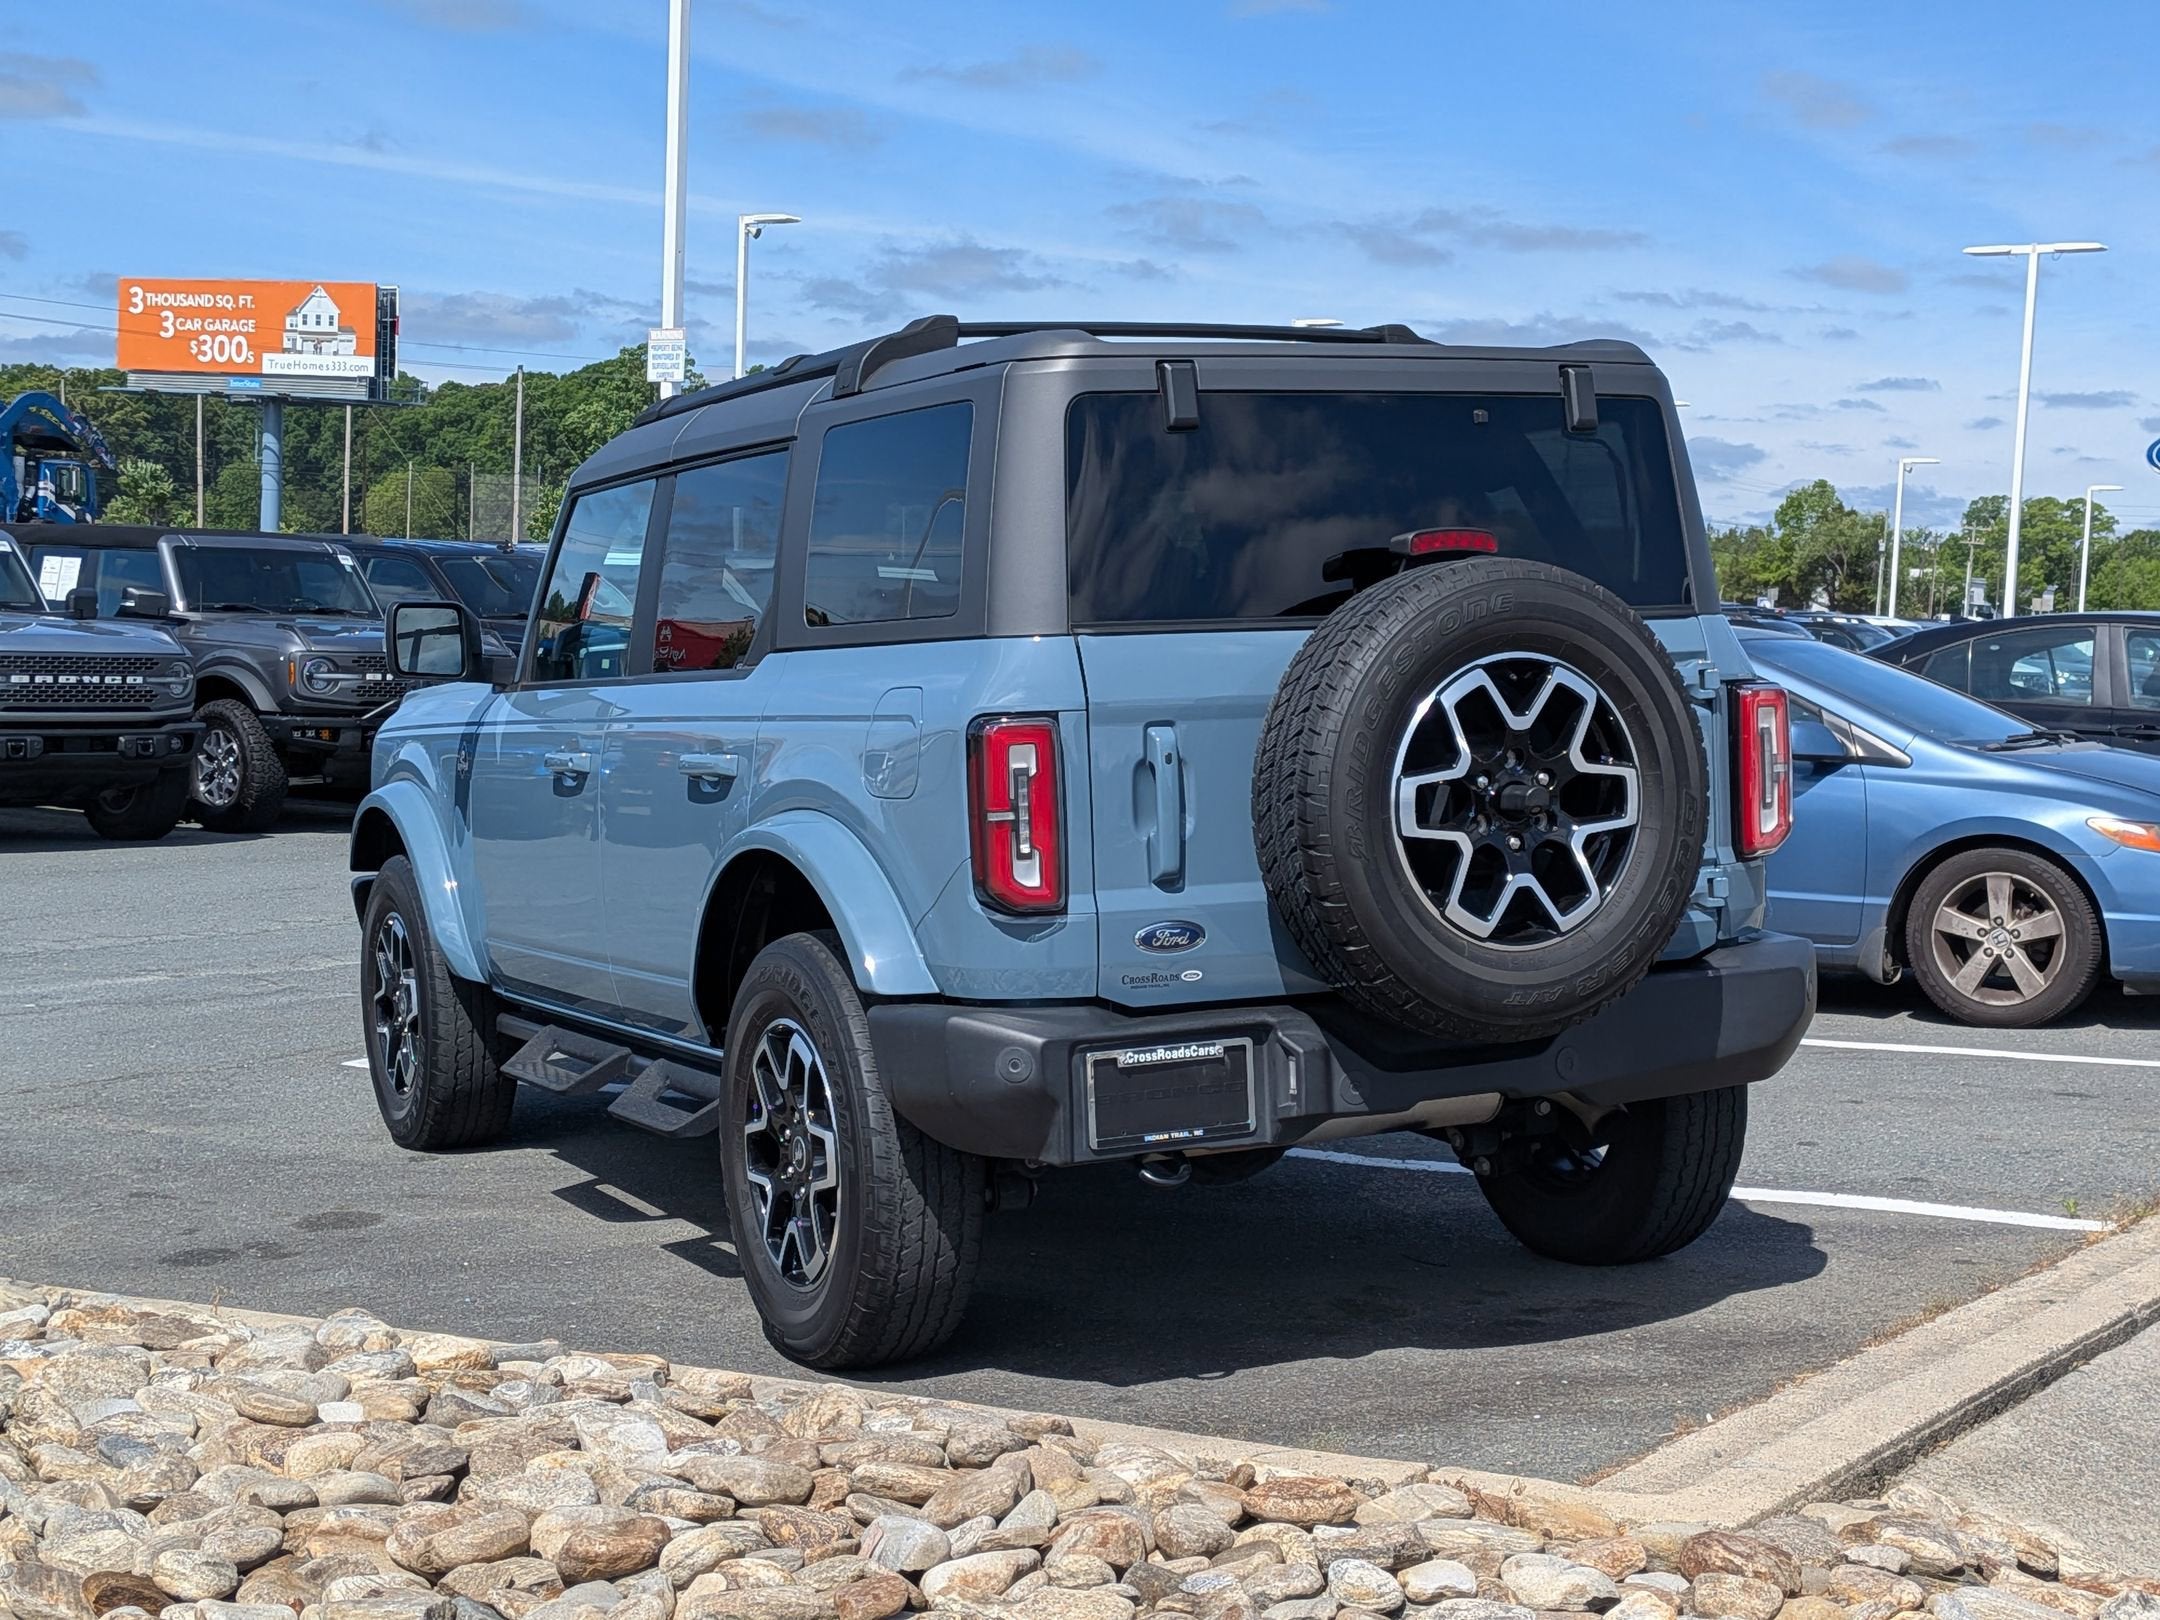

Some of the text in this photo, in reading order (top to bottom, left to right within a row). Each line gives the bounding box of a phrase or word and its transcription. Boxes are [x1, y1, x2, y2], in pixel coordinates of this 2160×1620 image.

[128, 286, 256, 314] 3 THOUSAND SQ. FT.
[159, 310, 256, 338] 3 CAR GARAGE
[267, 359, 369, 372] TrueHomes333.com
[10, 675, 144, 684] BRONCO
[1345, 591, 1514, 863] BRIDGESTONE
[1151, 928, 1190, 947] Ford
[1126, 1044, 1215, 1065] CrossRoadsCars
